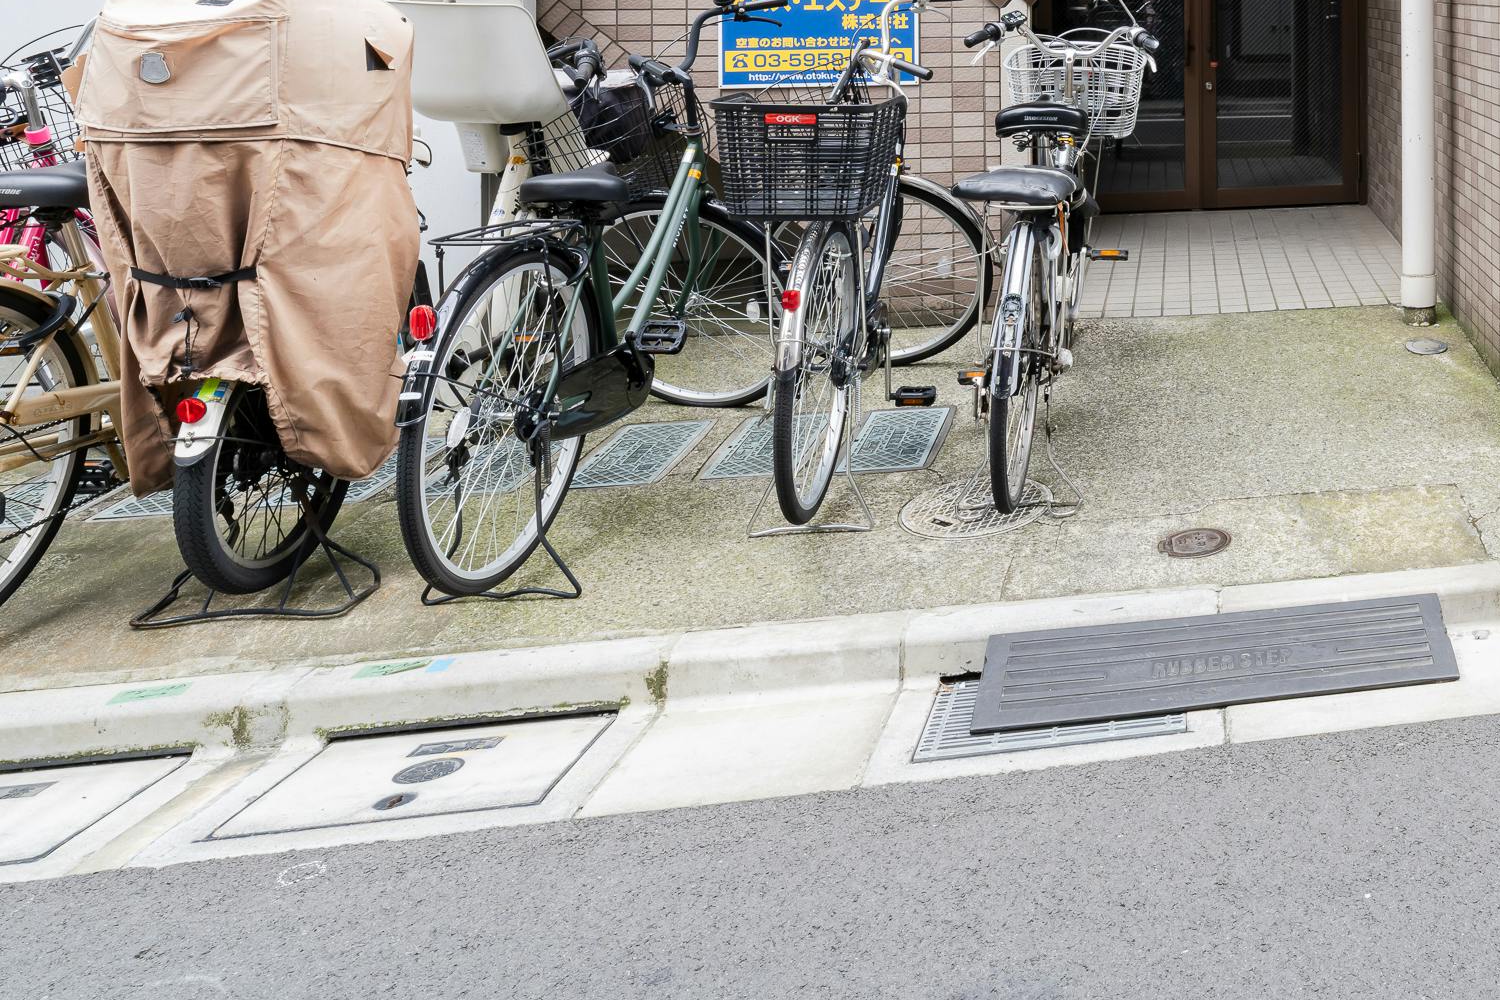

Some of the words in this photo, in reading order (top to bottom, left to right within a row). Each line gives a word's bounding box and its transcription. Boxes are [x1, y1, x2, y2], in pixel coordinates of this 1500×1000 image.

[735, 35, 902, 49] 空室のお問い合わせは、ちへ
[776, 114, 800, 123] OGK
[1240, 648, 1293, 668] STEP
